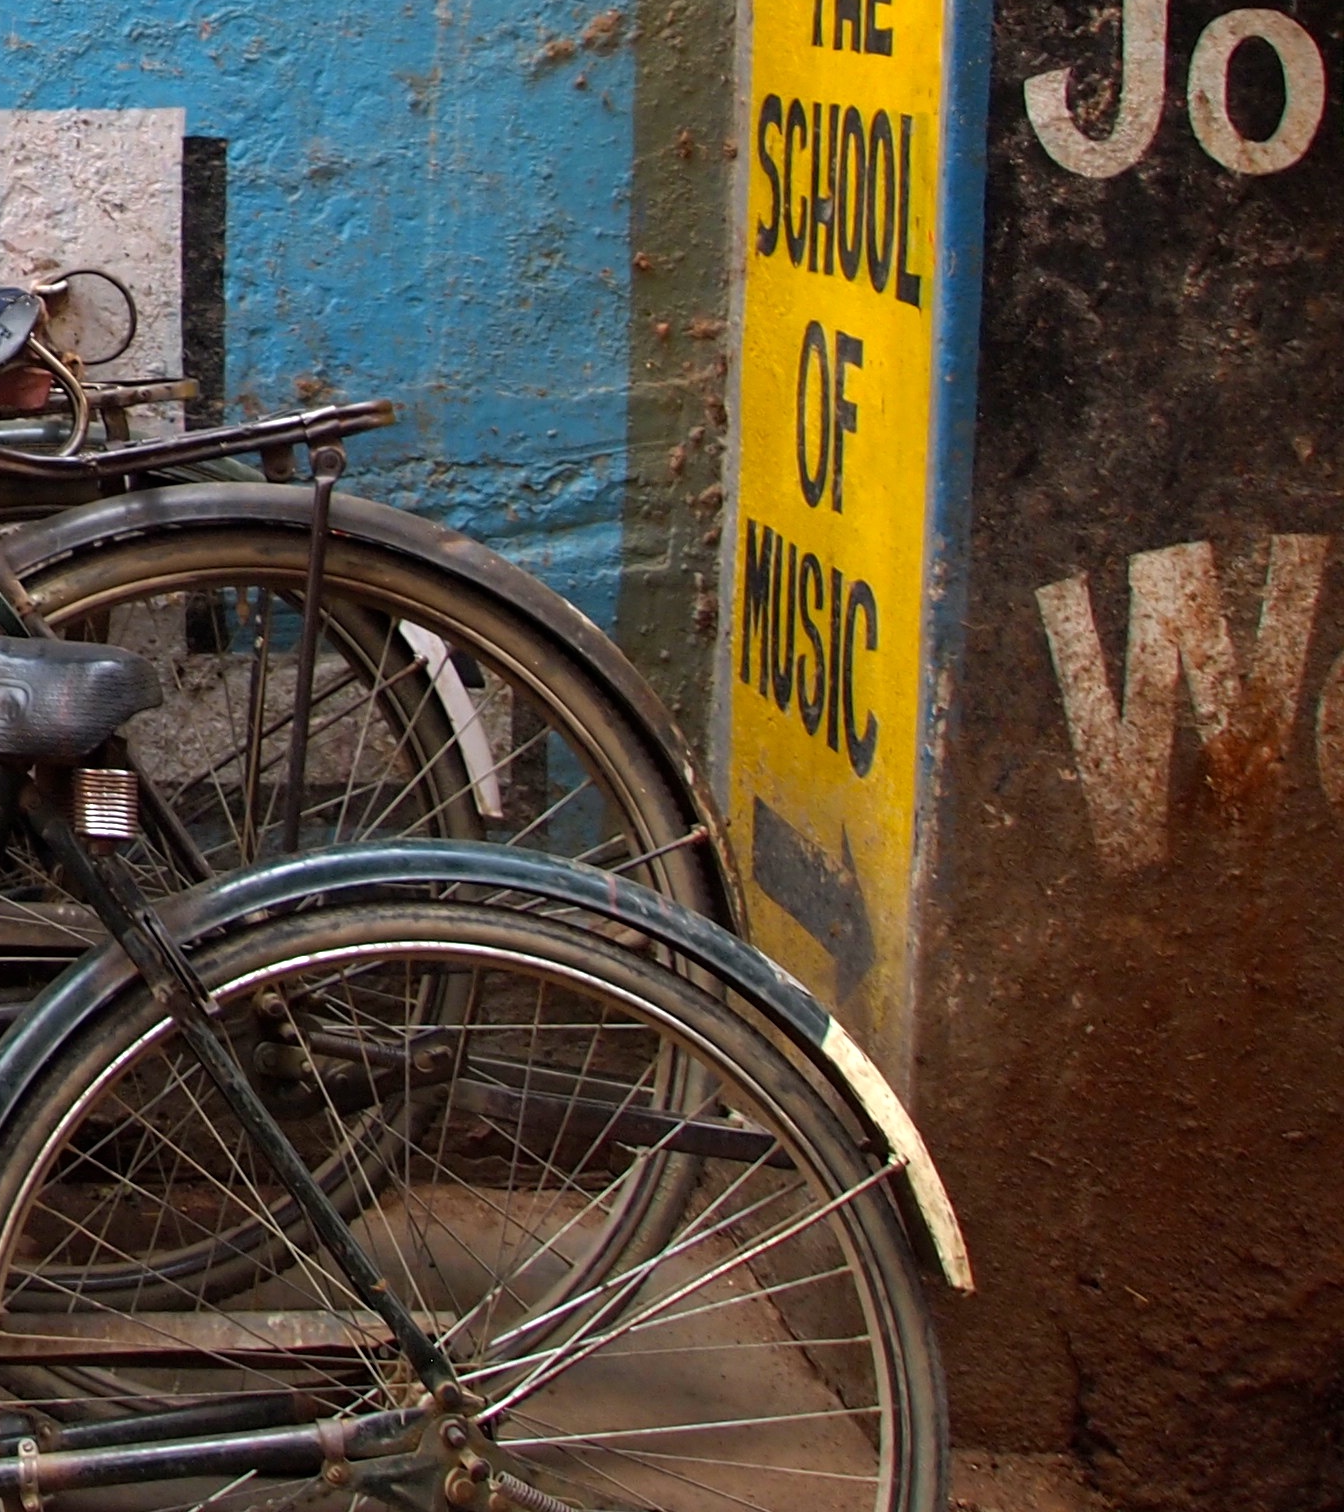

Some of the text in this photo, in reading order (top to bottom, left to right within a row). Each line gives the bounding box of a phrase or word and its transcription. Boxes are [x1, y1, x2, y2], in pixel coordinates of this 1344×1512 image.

[757, 92, 922, 309] SCHOOL
[796, 319, 864, 515] OF
[739, 517, 878, 780] MUSIC
[1034, 532, 1344, 873] W
